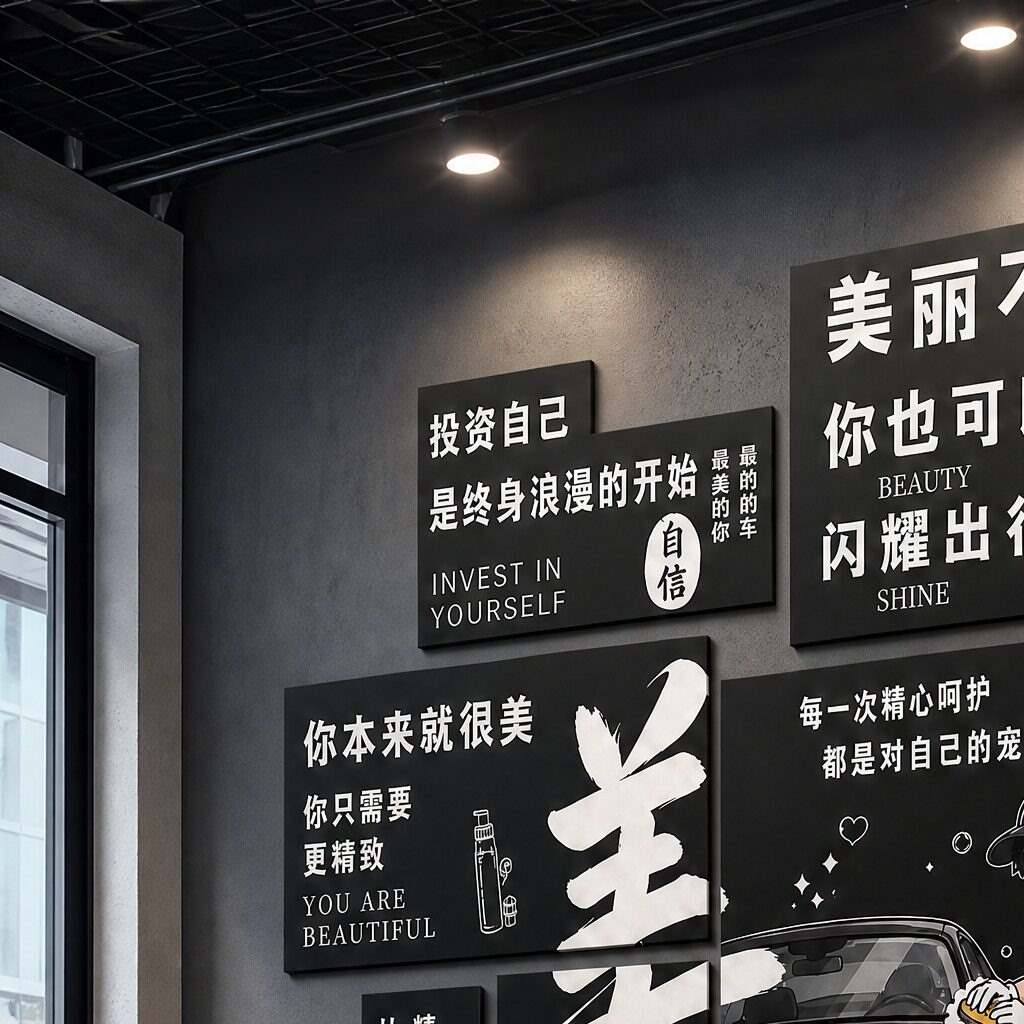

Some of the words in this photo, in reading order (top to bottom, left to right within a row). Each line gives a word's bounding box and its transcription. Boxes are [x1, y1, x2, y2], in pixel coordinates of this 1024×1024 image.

[429, 395, 569, 459] 投资自己
[429, 452, 698, 533] 是终身浪漫的开始
[711, 448, 730, 544] 最美的你
[738, 444, 758, 540] 最的的车
[877, 464, 972, 500] BEAUTY
[432, 561, 524, 596] INVEST
[536, 556, 561, 582] IN
[656, 520, 687, 602] 自信
[430, 590, 566, 629] YOURSELF
[877, 581, 950, 612] SHINE
[799, 674, 990, 731] 每一次精心呵护
[303, 694, 533, 769] 你本来就很美
[303, 785, 412, 831] 你只需要
[303, 836, 385, 878] 更精致
[302, 892, 351, 917] YOU
[359, 888, 406, 912] ARE
[302, 917, 436, 948] BEAUTIFUL
